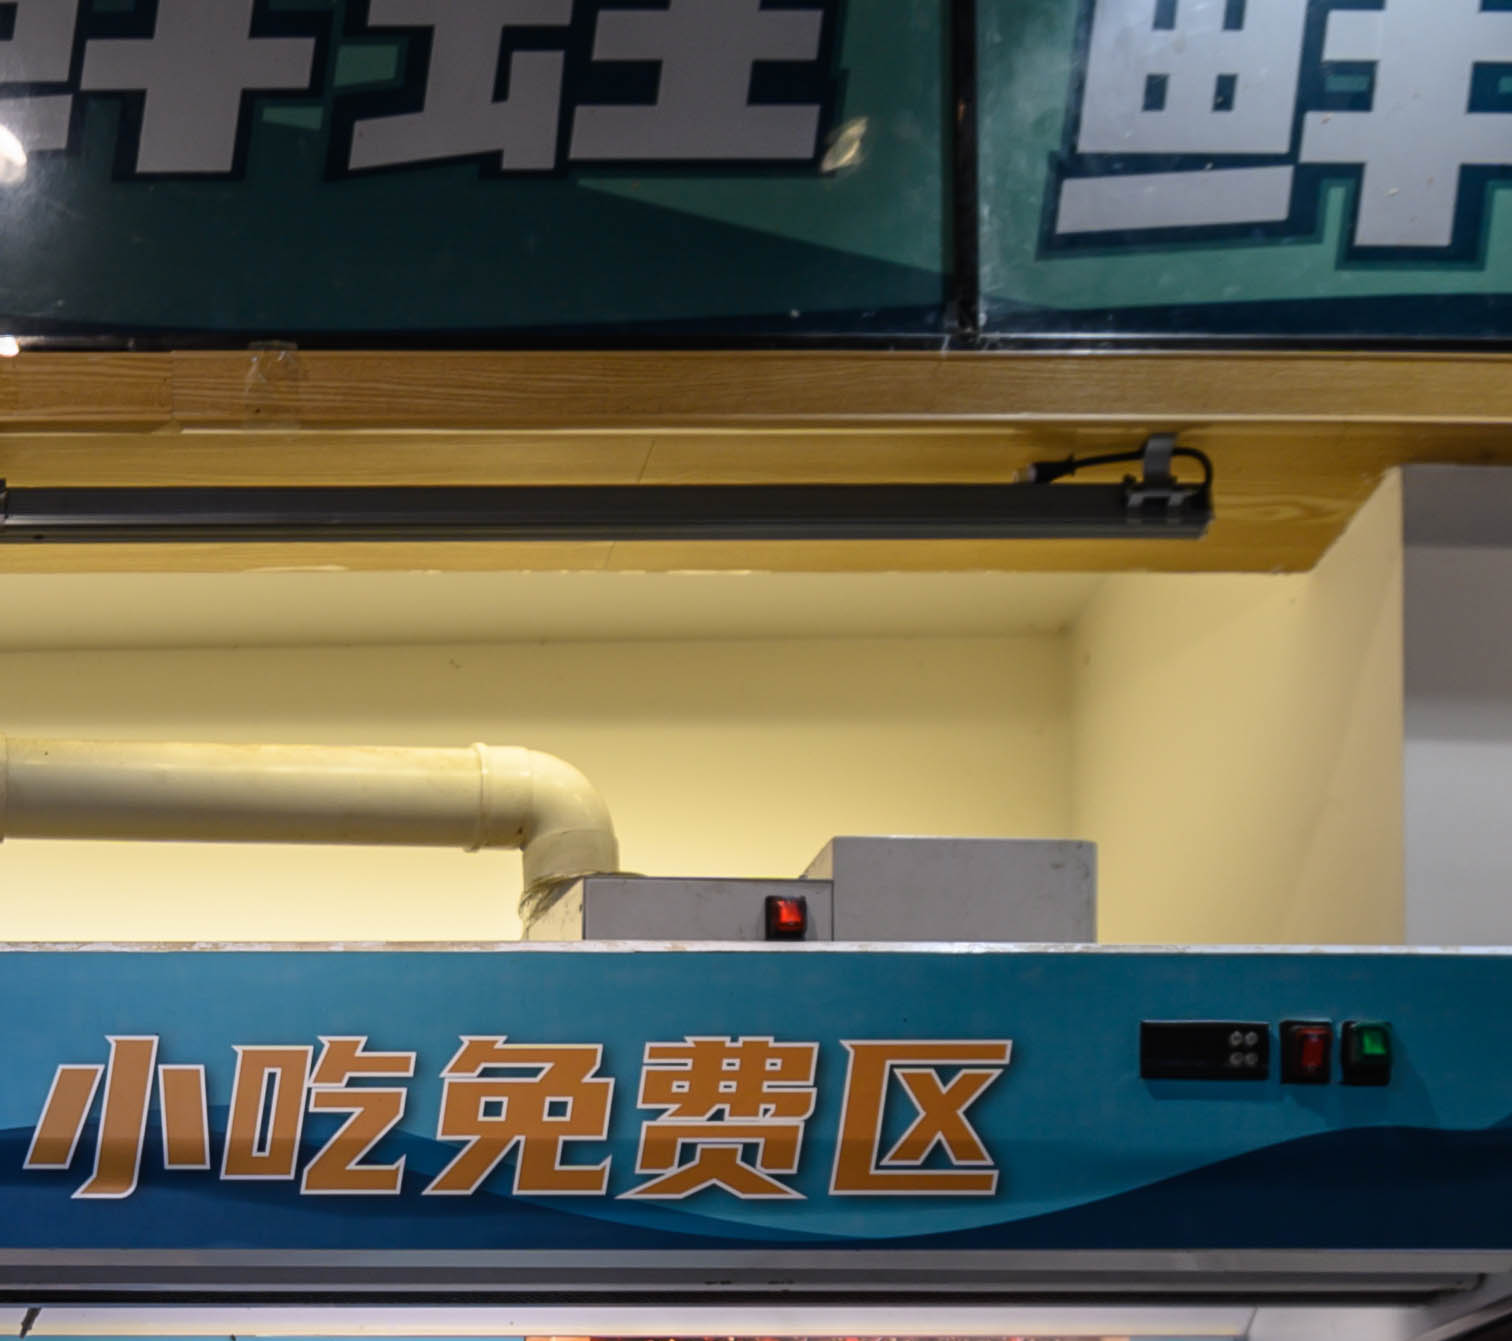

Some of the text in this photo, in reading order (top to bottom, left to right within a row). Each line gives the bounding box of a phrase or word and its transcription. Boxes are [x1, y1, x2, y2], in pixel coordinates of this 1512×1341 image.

[20, 1033, 1014, 1203] 小吃免费区
